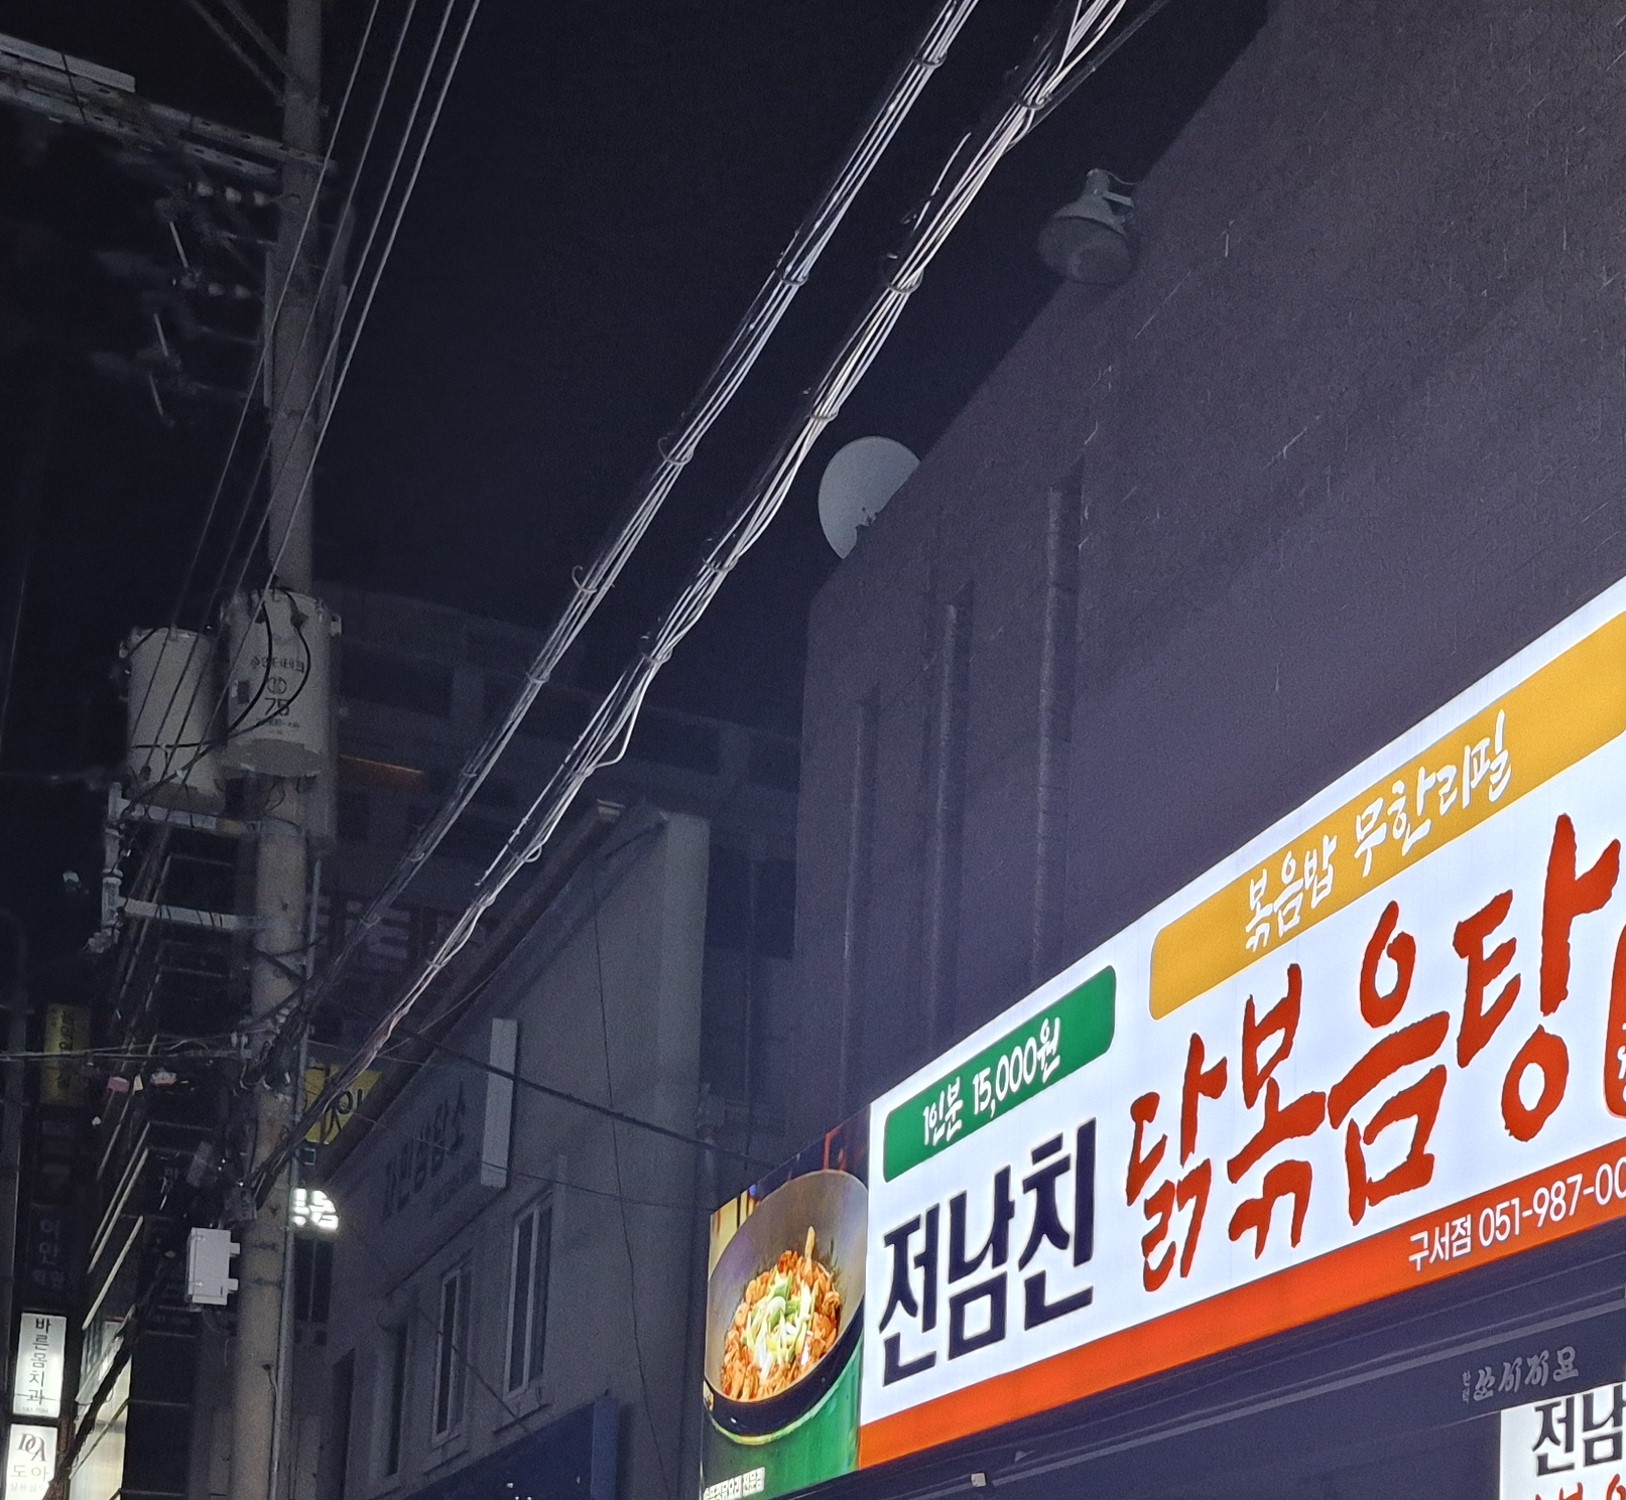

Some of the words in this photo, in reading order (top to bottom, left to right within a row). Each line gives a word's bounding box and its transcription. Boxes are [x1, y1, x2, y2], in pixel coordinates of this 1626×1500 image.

[1244, 834, 1336, 952] 볶음밥
[1354, 708, 1511, 867] 무한리필
[922, 1083, 964, 1147] 1인분
[972, 1016, 1063, 1118] 15,000원
[1126, 813, 1620, 1293] 닭볶음탕
[879, 1118, 1098, 1385] 전남친
[1408, 1223, 1473, 1271] 구서점
[26, 1317, 52, 1405] 바른몸치과
